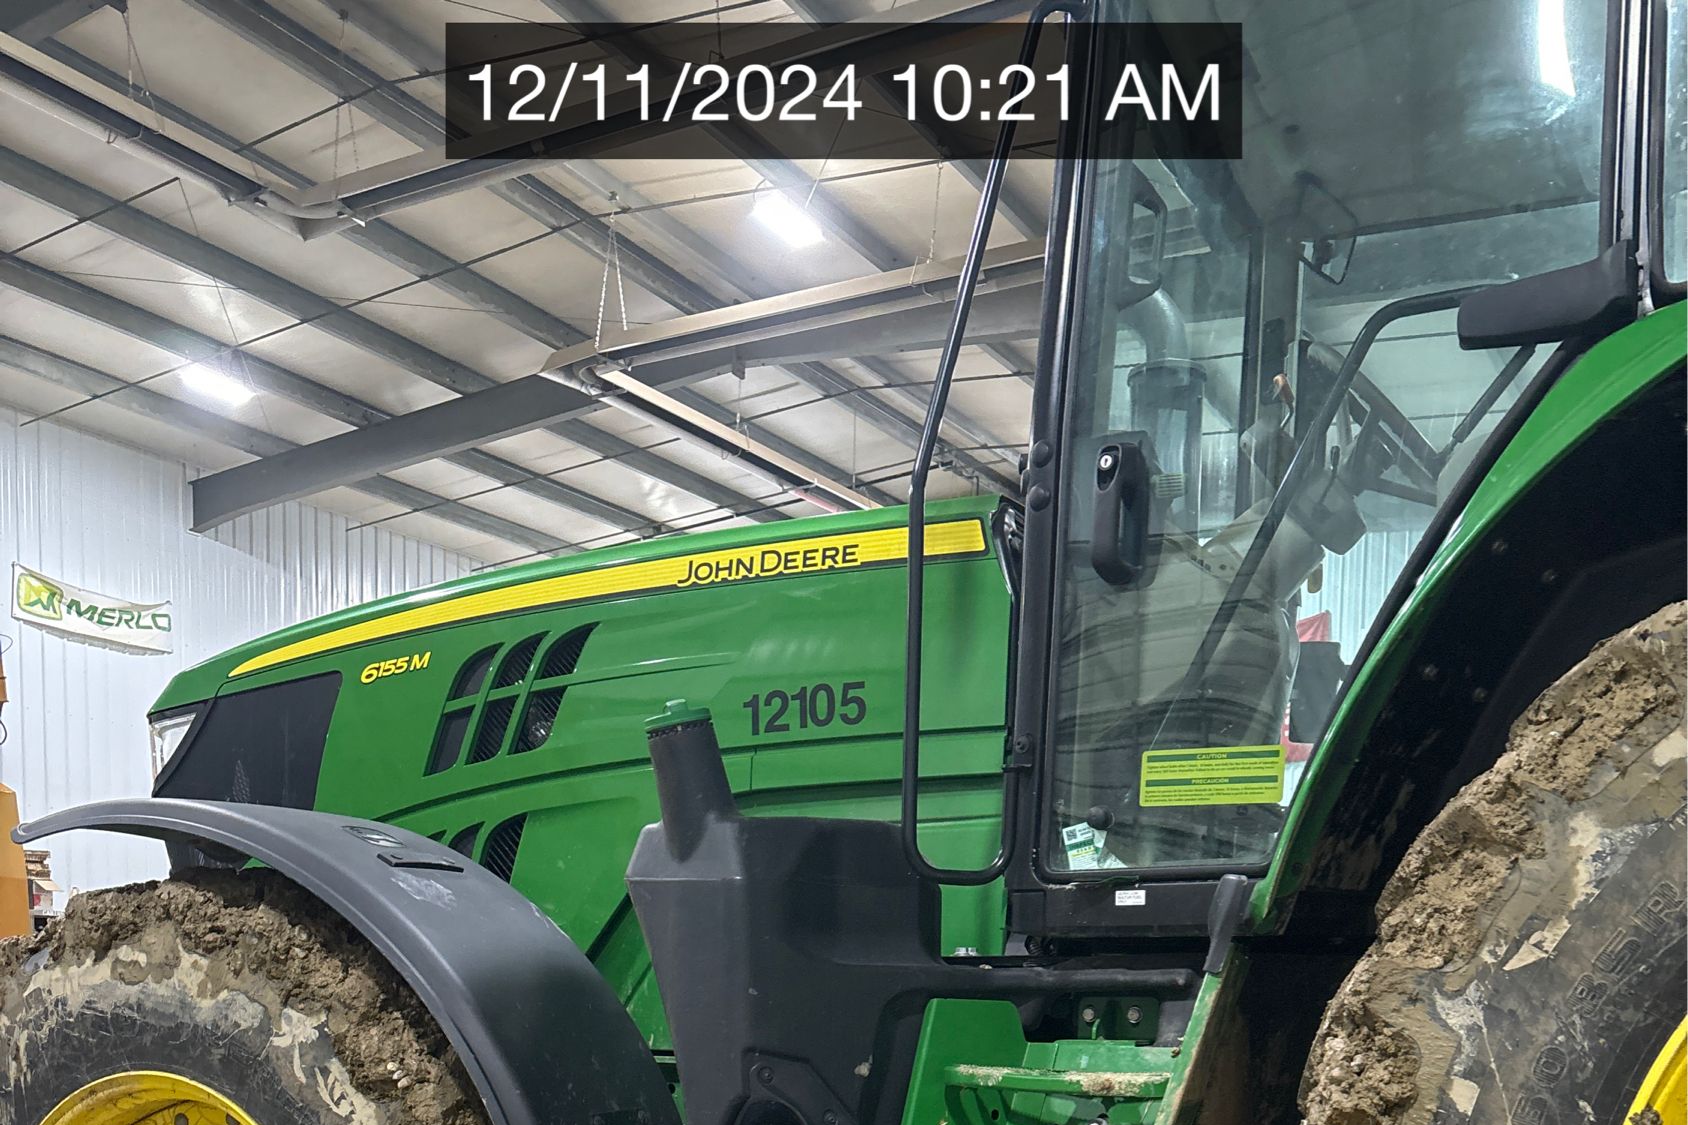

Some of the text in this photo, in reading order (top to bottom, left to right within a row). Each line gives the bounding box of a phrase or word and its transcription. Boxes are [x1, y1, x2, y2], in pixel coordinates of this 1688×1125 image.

[677, 544, 860, 584] JOHN DEERE
[66, 597, 172, 633] MERLO
[743, 681, 867, 736] 12105
[1196, 752, 1228, 760] CAUTION
